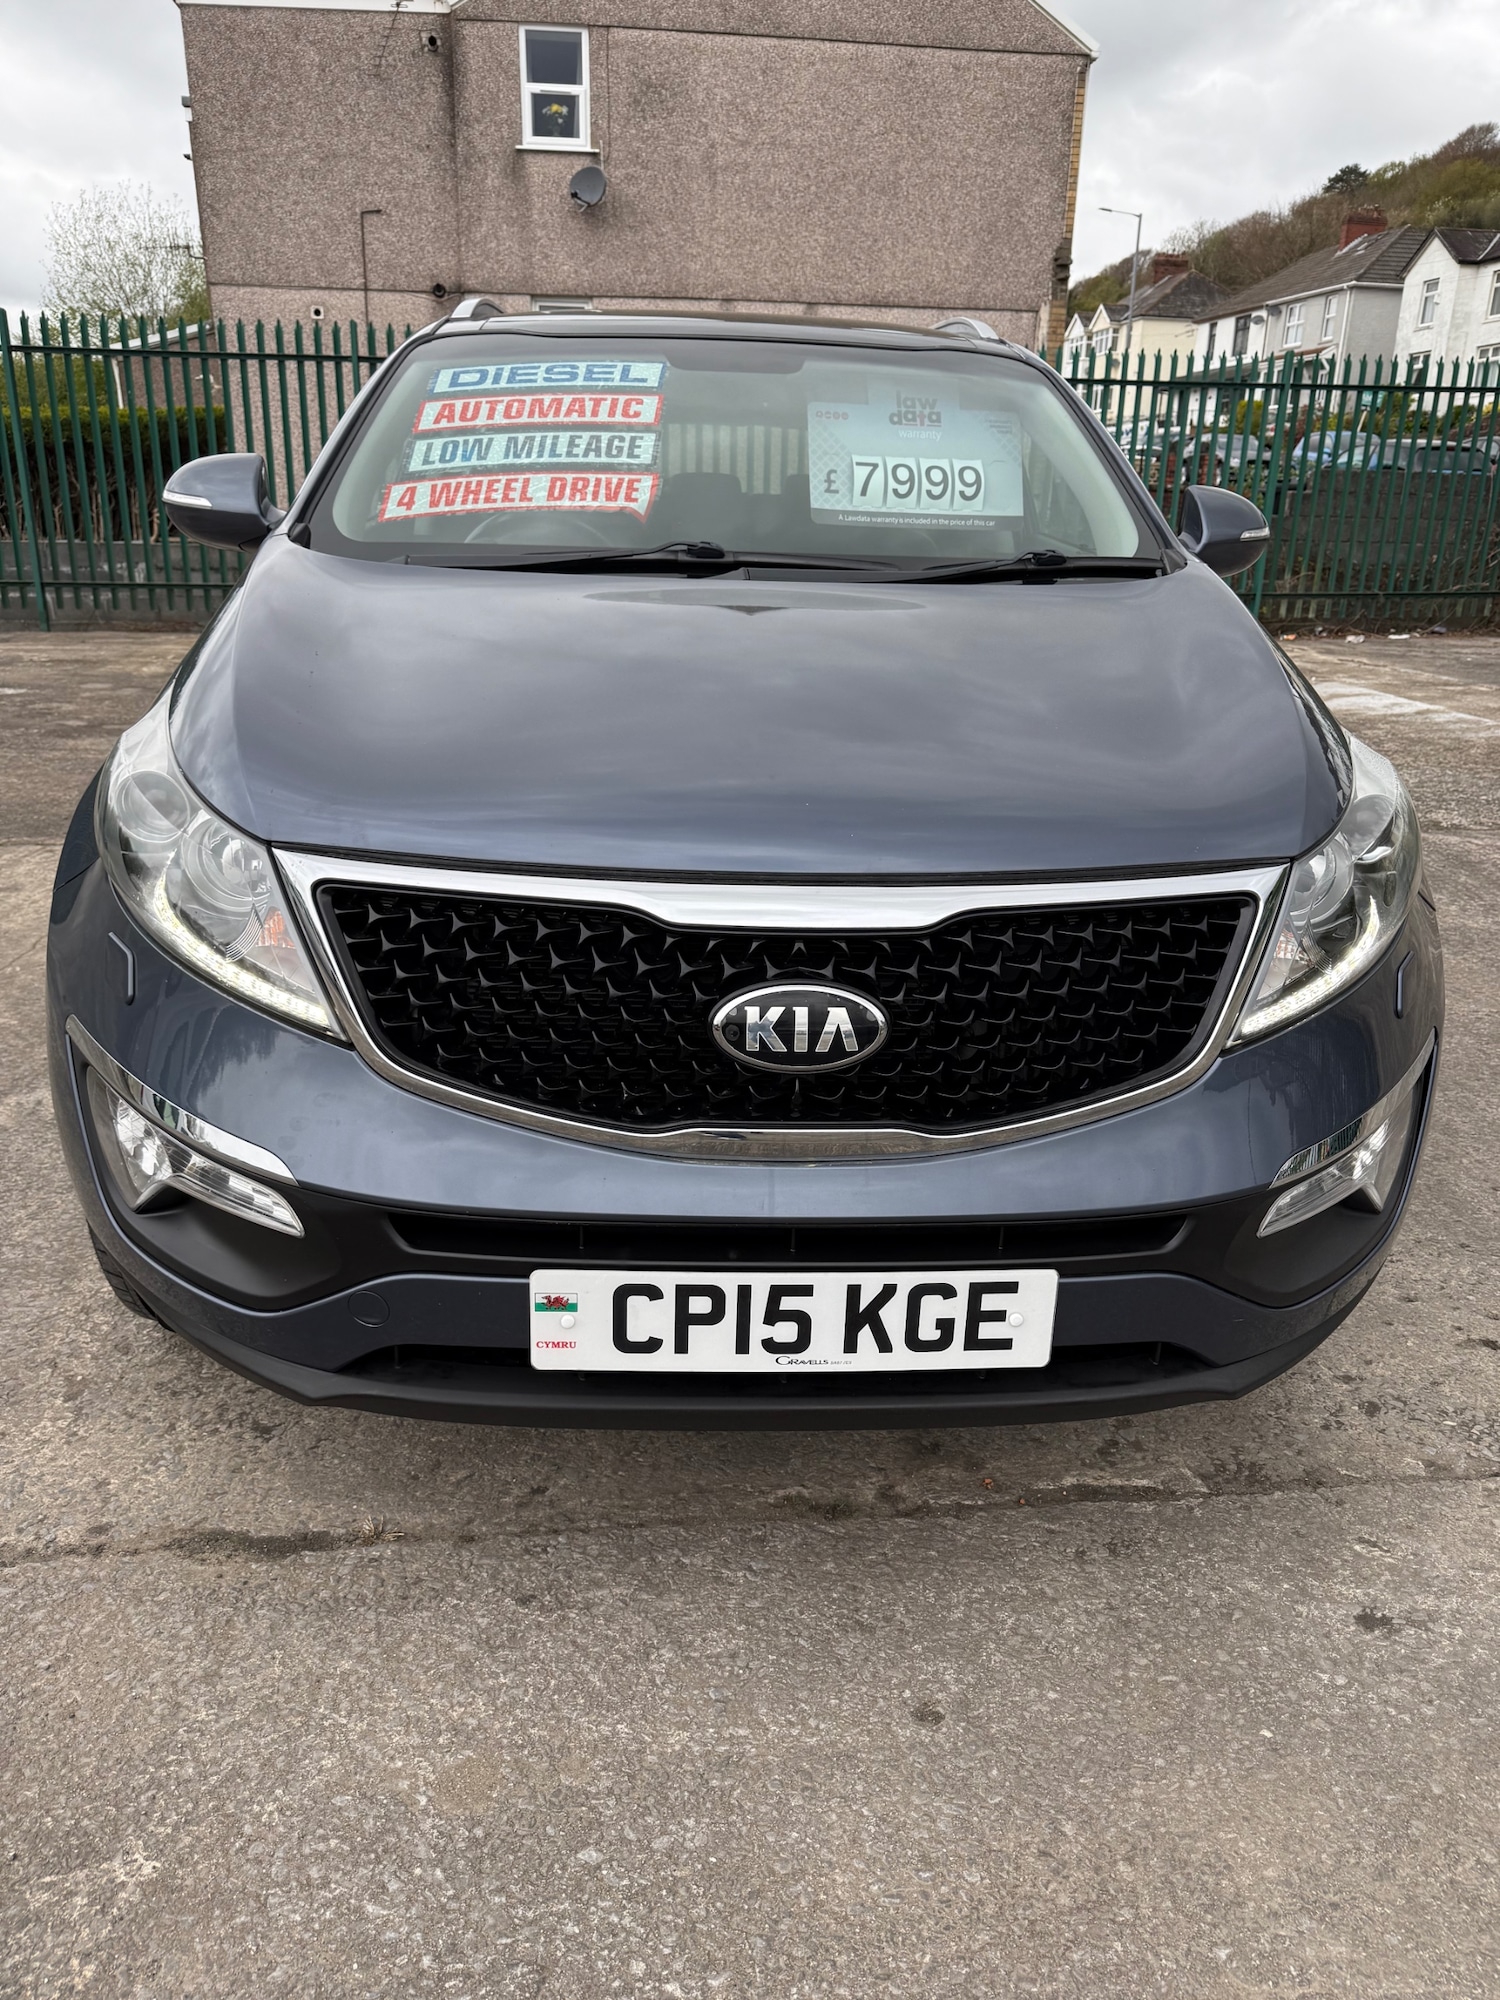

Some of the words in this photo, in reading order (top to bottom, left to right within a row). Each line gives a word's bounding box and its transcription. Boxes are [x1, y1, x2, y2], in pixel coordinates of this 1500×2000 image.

[448, 363, 650, 388] DIESEL
[432, 397, 645, 425] AUTOMATIC
[889, 409, 942, 427] data
[898, 430, 943, 442] warranty
[421, 436, 494, 466] LOW
[503, 434, 644, 460] MILEAGE
[396, 485, 417, 511] 4
[429, 477, 535, 509] WHEEL
[546, 476, 642, 504] DRIVE
[838, 513, 844, 521] A
[844, 513, 871, 522] Lawdata
[871, 515, 899, 525] warranty
[904, 516, 931, 525] included
[938, 517, 949, 526] the
[949, 518, 965, 527] price
[965, 518, 973, 526] of
[973, 519, 985, 527] this
[744, 1006, 859, 1053] KIA
[612, 1283, 813, 1354] CP15
[843, 1281, 1020, 1354] KGE
[536, 1340, 577, 1349] CYMRU
